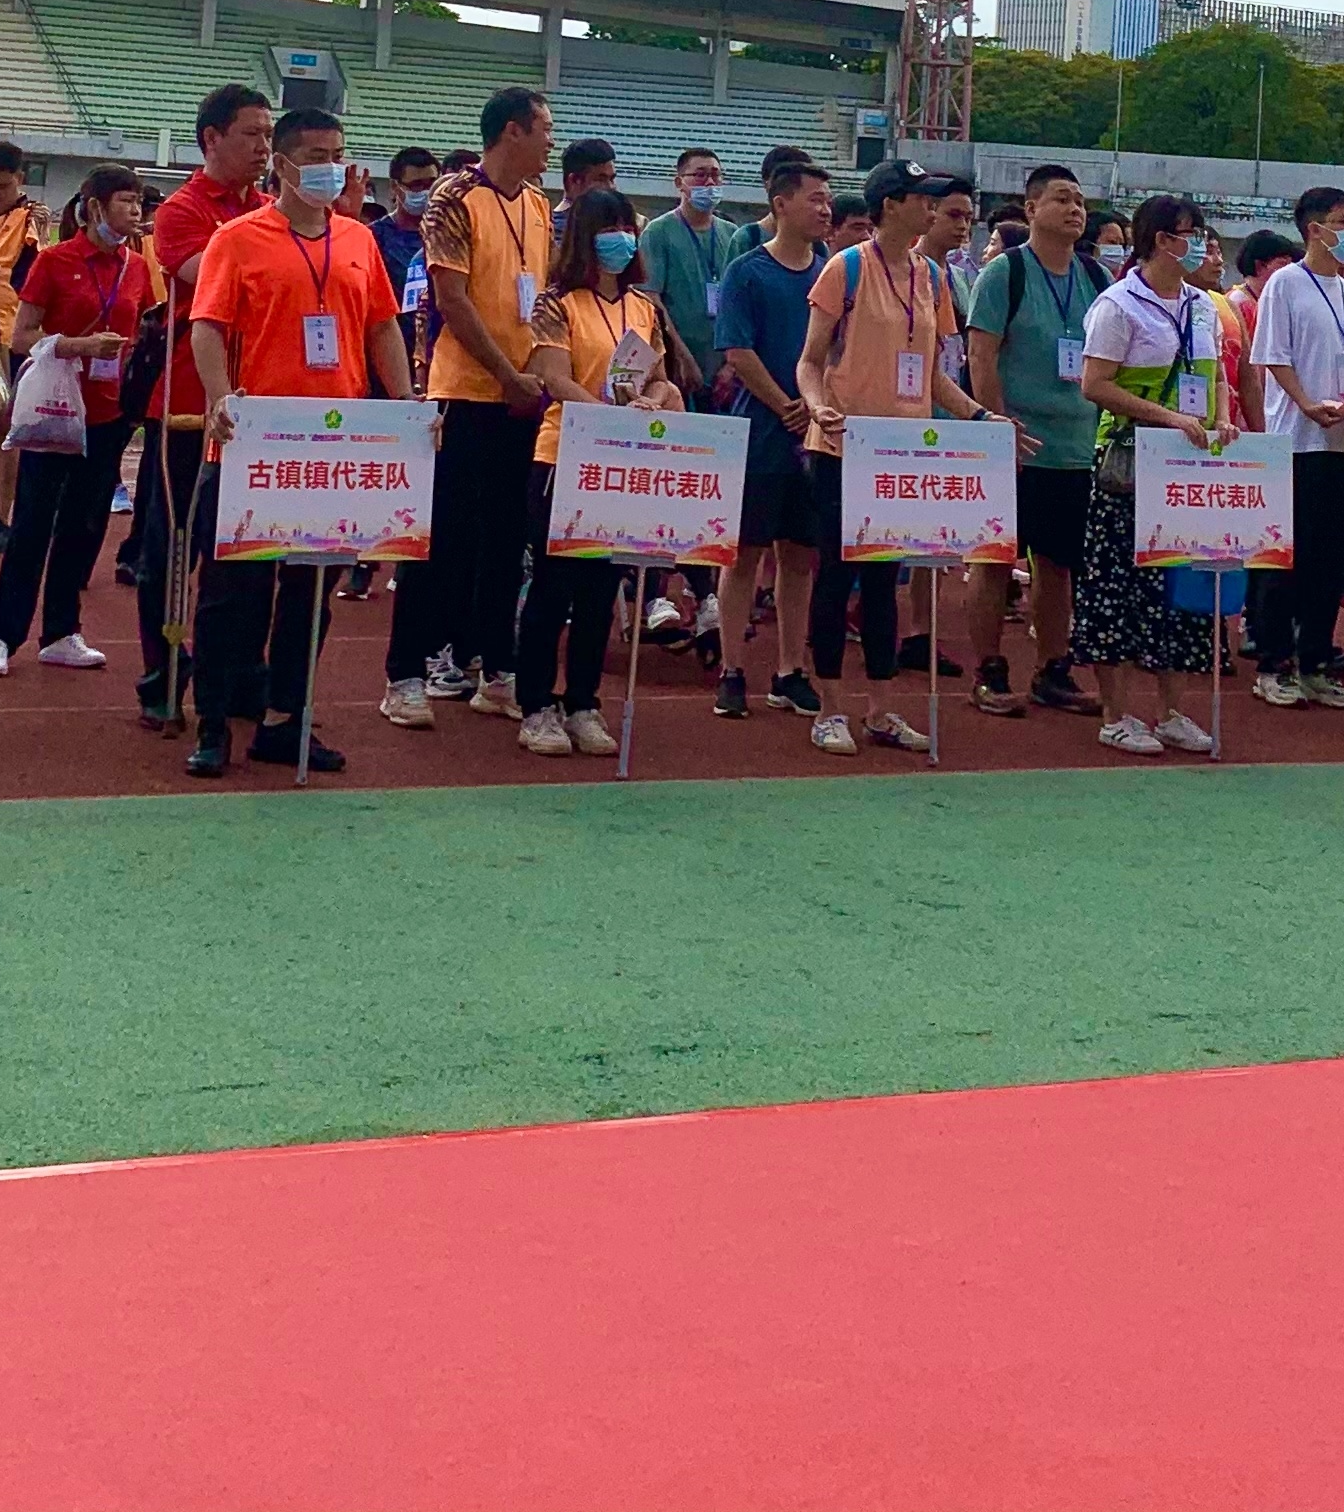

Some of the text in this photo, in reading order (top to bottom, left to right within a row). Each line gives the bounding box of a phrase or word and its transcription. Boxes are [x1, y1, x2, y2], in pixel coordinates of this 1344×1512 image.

[246, 459, 411, 491] 古镇镇代表队
[577, 462, 723, 501] 港口镇代表队
[874, 472, 987, 502] 南区代表队
[1164, 481, 1267, 509] 东区代表队
